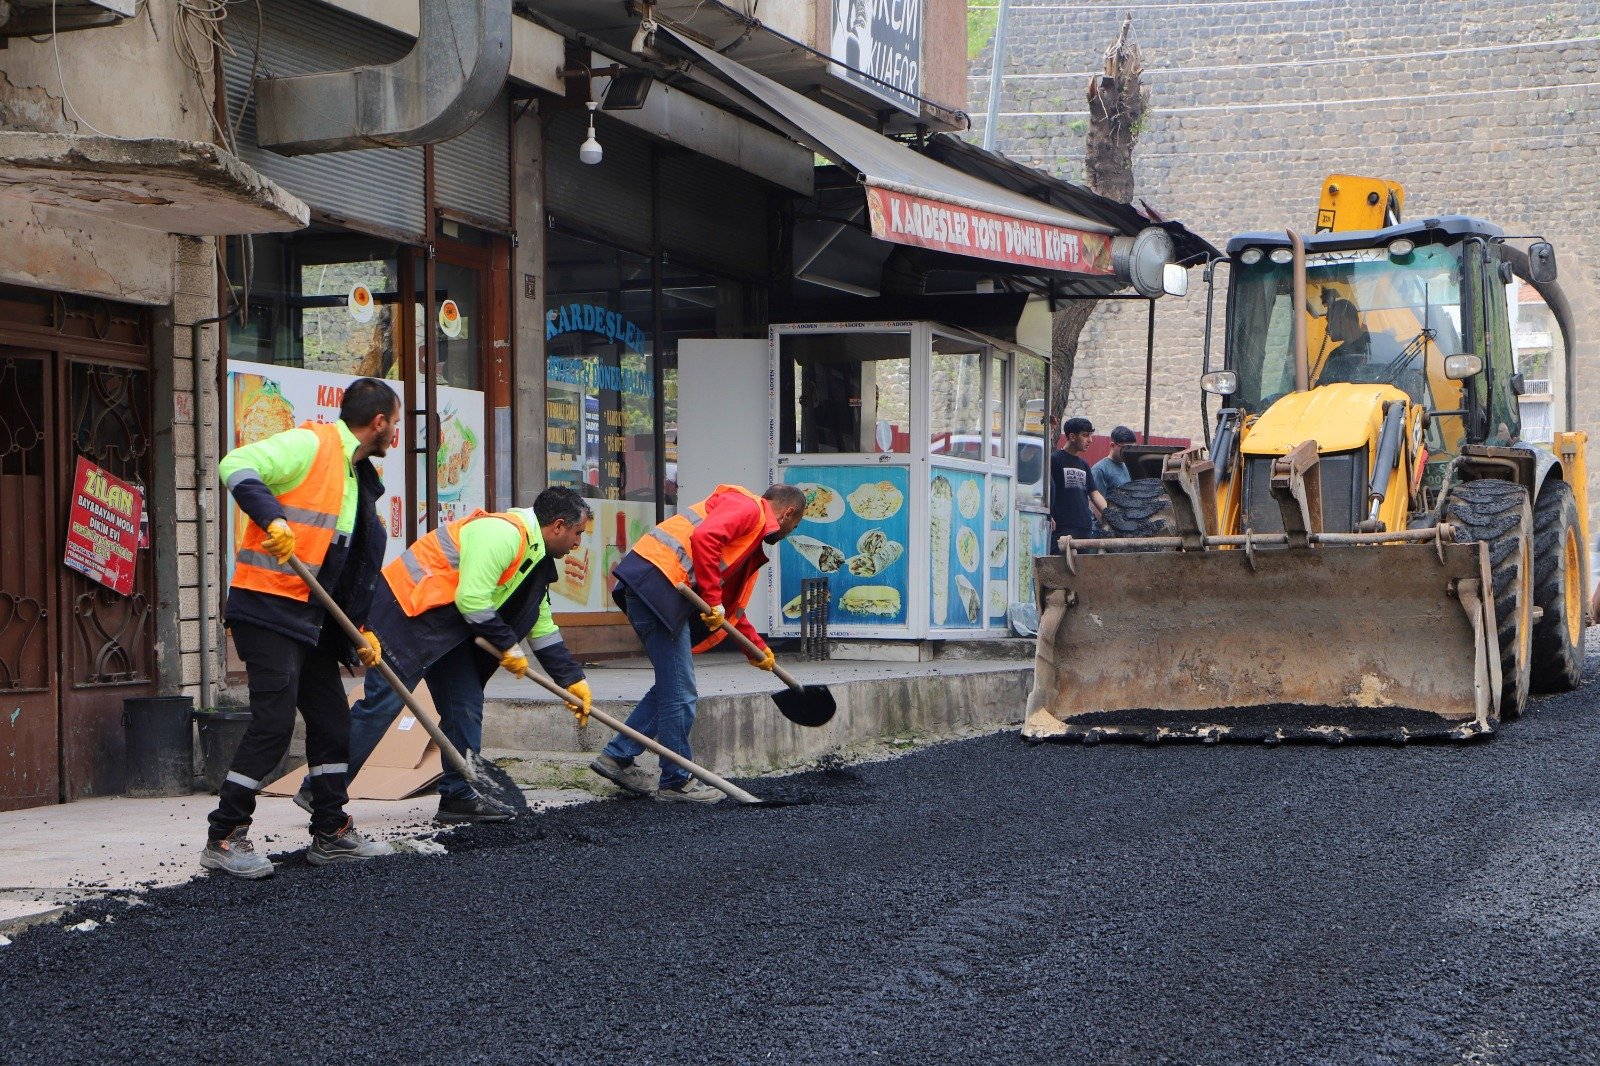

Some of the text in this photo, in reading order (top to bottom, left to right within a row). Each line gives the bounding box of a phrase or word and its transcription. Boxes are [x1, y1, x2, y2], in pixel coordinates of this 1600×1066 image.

[866, 39, 918, 105] KUAFÖR
[890, 198, 1080, 264] KARDEŞLER TOST DÖNER KÖFTE
[546, 303, 646, 357] KARDEŞLER
[593, 357, 621, 391] DÖNER
[78, 495, 116, 524] BAY&BAYAN
[116, 514, 135, 535] MODA
[110, 526, 121, 542] EVİ
